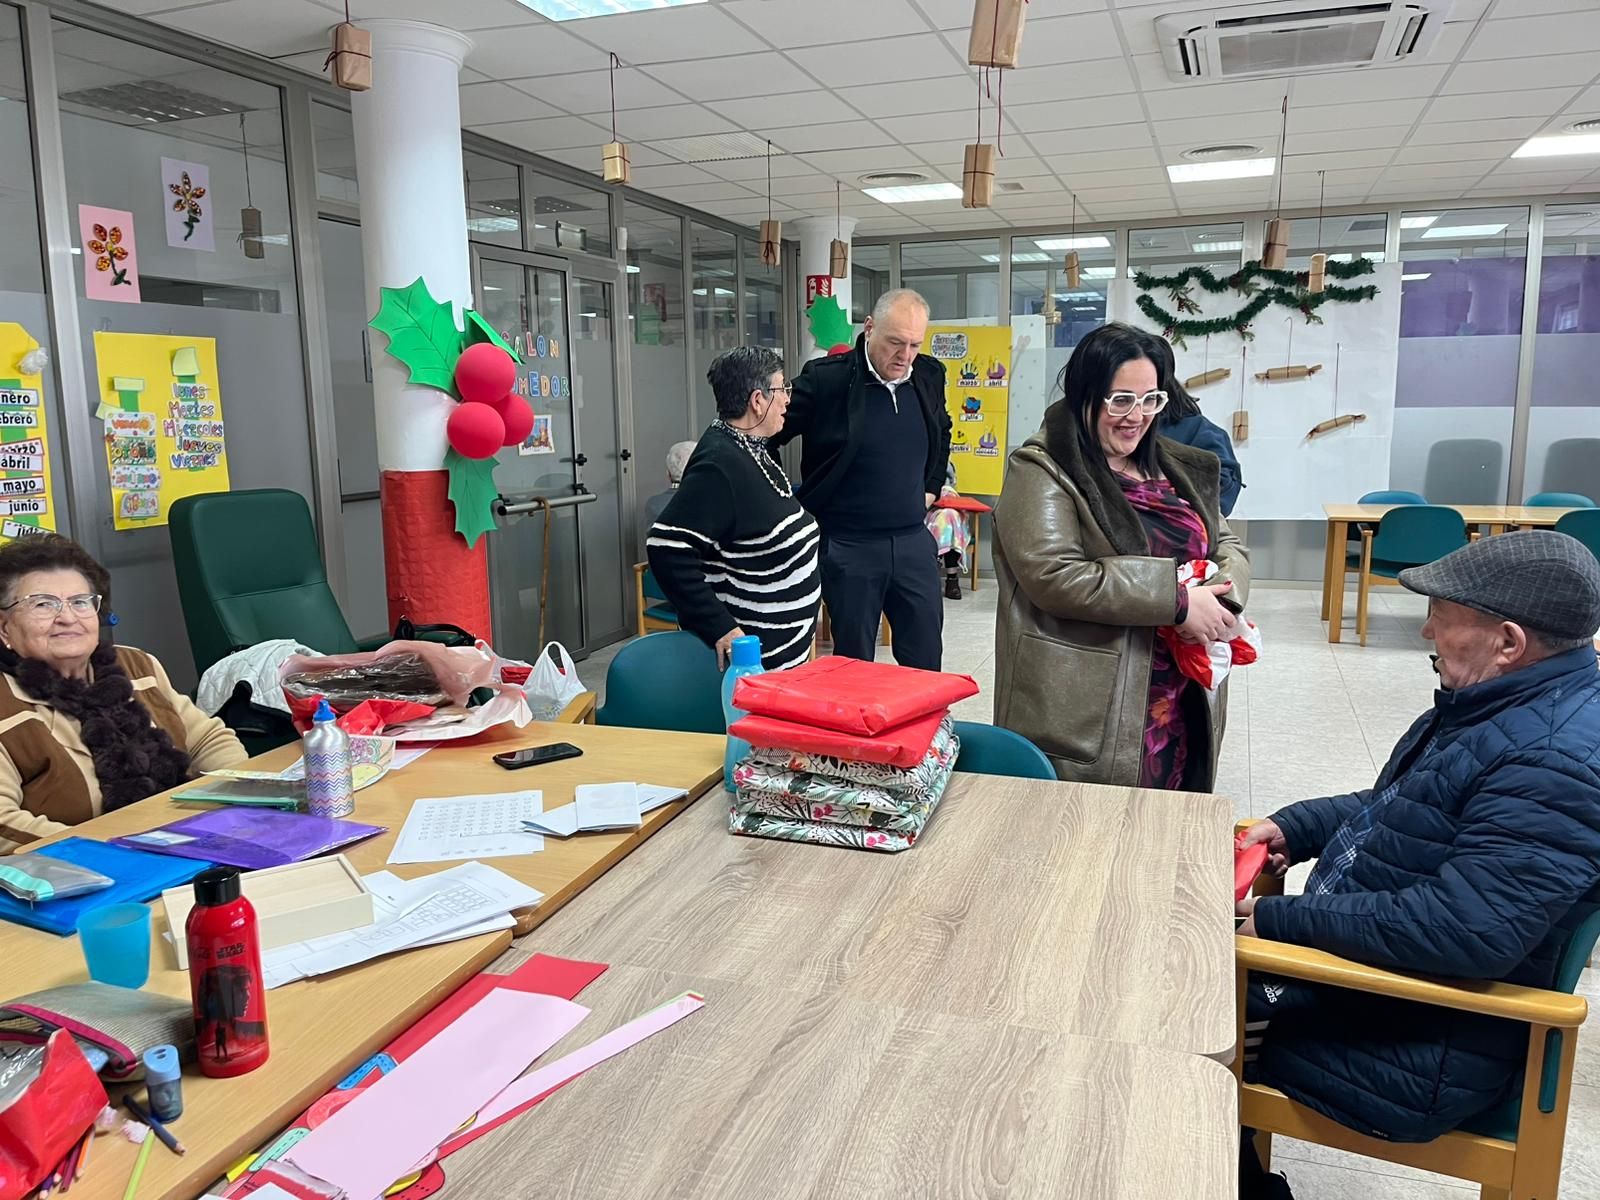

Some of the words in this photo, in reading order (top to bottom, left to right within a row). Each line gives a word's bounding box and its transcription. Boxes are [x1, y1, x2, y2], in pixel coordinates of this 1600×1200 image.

[512, 371, 570, 398] MEDOR
[0, 394, 31, 404] nero
[1, 456, 30, 469] abril
[3, 480, 36, 493] mayo
[8, 499, 39, 515] junio
